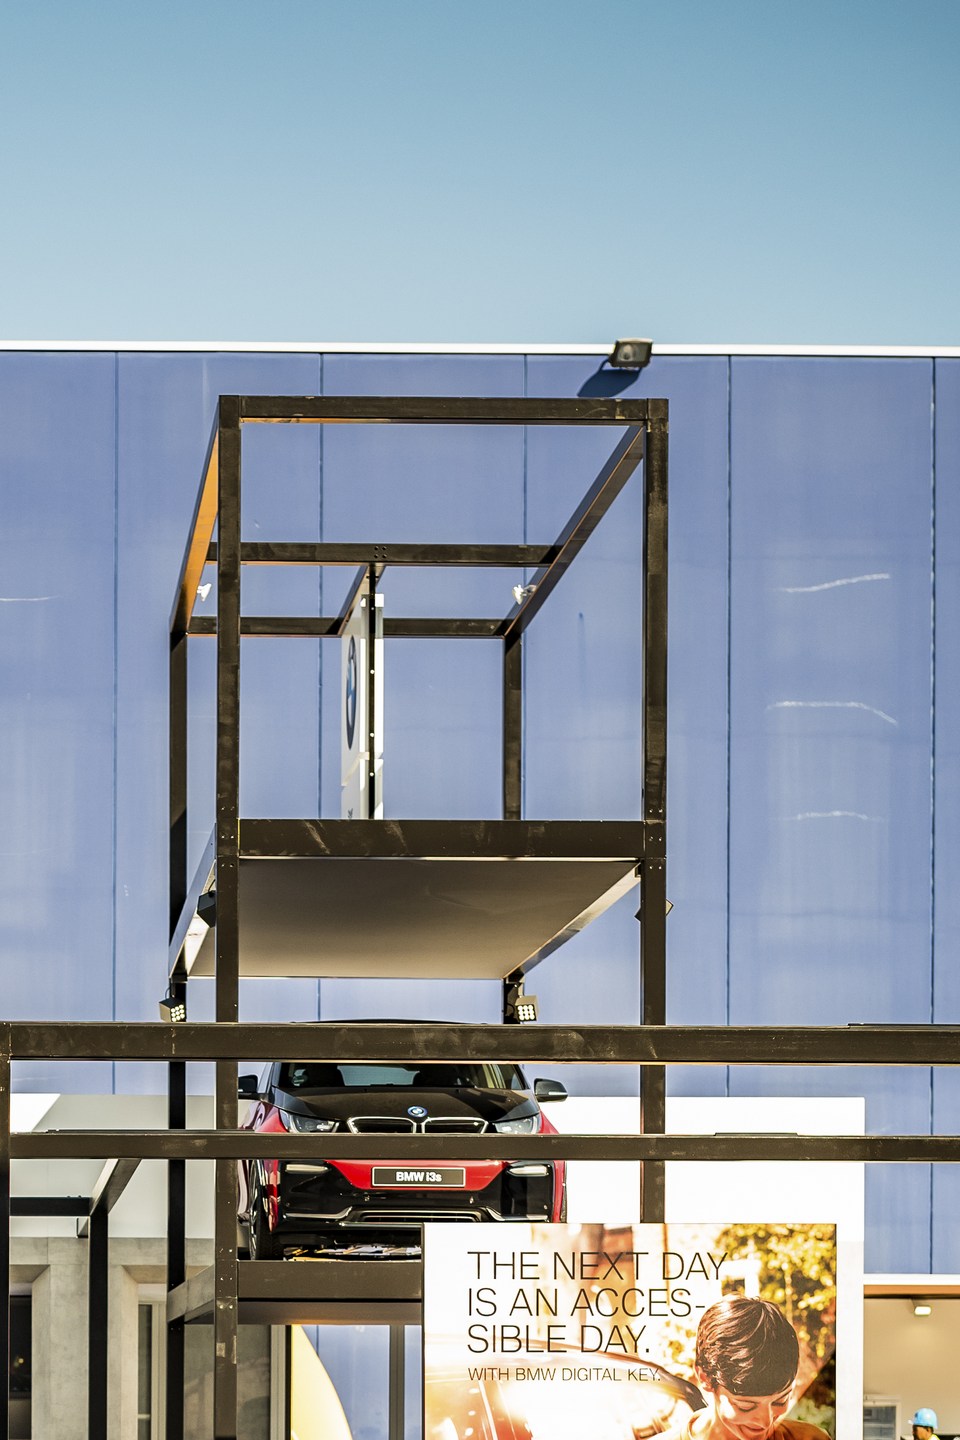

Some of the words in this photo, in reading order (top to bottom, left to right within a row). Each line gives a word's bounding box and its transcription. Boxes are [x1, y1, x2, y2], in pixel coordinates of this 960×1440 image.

[395, 1171, 425, 1182] BMW
[426, 1171, 442, 1182] i3s
[467, 1251, 540, 1280] THE
[553, 1251, 649, 1280] NEXT
[662, 1251, 728, 1280] DAY
[468, 1287, 497, 1317] IS
[509, 1288, 558, 1317] AN
[570, 1287, 705, 1317] ACCES-
[467, 1324, 567, 1353] SIBLE
[581, 1325, 650, 1353] DAY.
[468, 1367, 509, 1381] WITH
[515, 1367, 556, 1381] BMW
[562, 1367, 622, 1381] DIGITAL
[628, 1367, 661, 1381] KEY.
